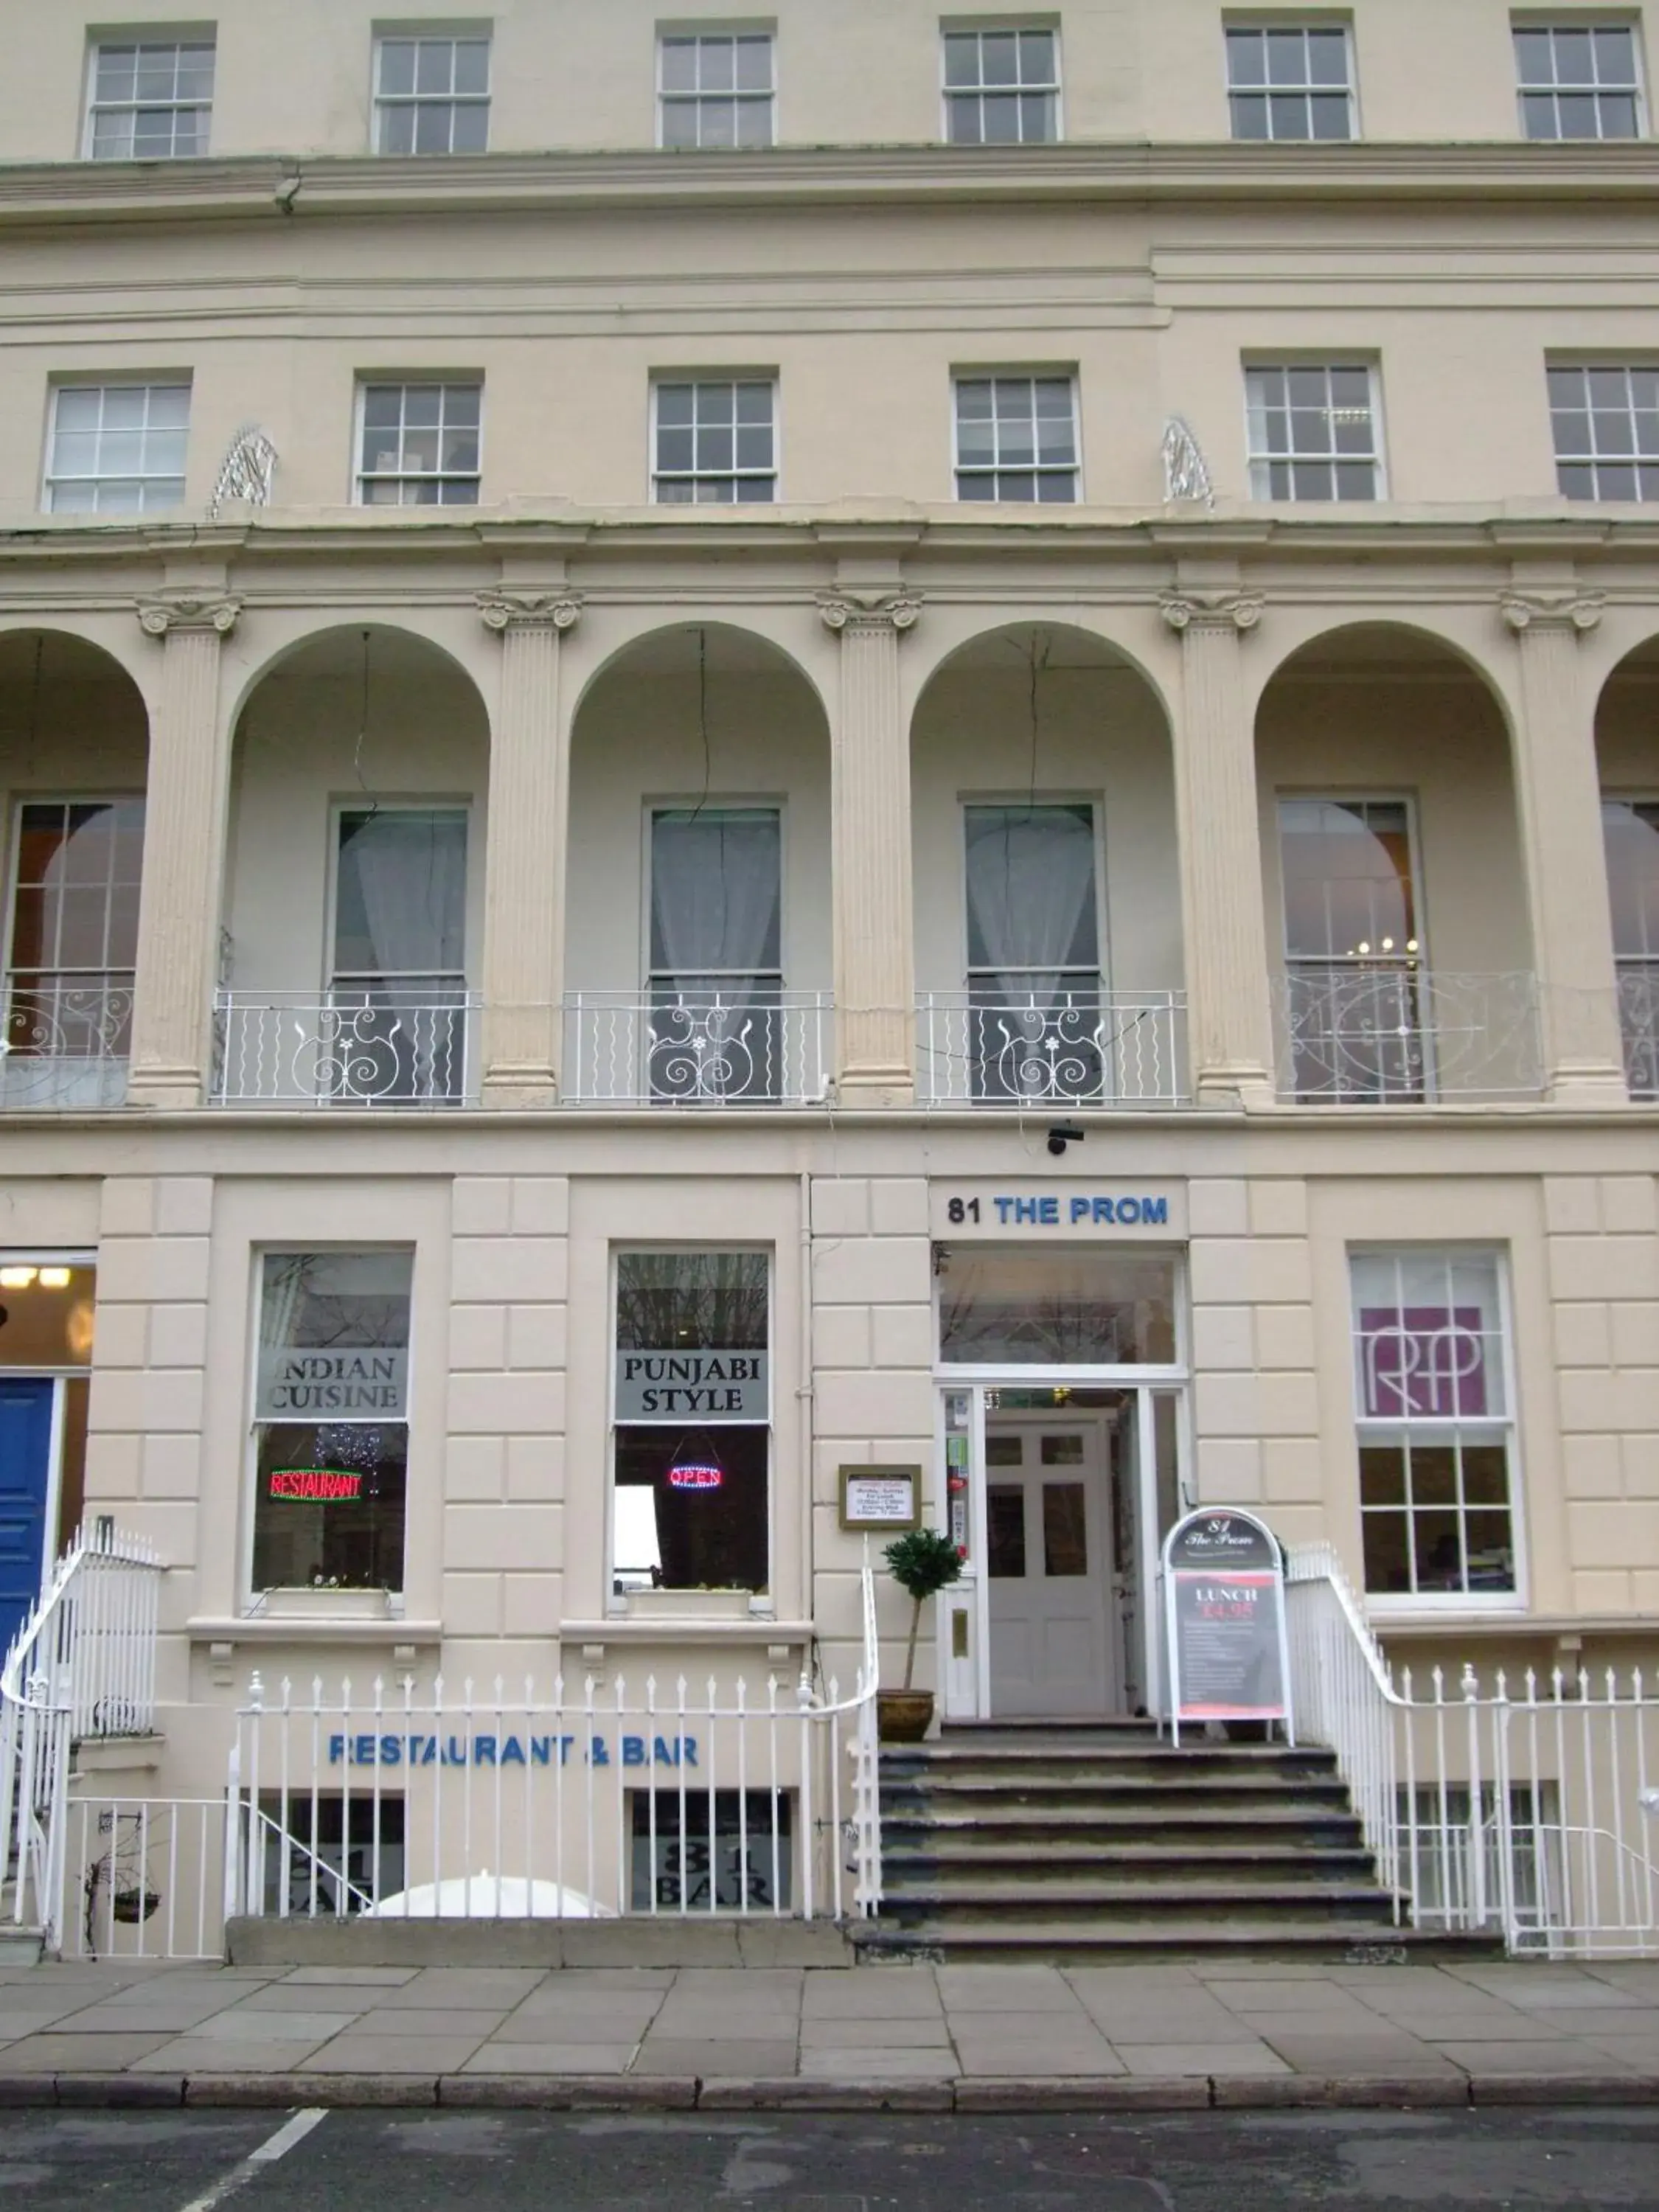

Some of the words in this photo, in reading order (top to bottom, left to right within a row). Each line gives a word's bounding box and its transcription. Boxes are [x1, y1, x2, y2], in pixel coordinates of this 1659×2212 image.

[947, 1197, 981, 1224] 81
[993, 1197, 1060, 1224] THE
[1070, 1197, 1168, 1224] PROM
[625, 1358, 760, 1385] PUNJABI
[273, 1385, 398, 1409] CUISINE
[641, 1388, 743, 1412] STYLE
[270, 1472, 361, 1499] RESTAURANT
[669, 1470, 721, 1485] OPEN
[1196, 1587, 1257, 1602] LUNCH
[329, 1735, 574, 1766] RESTAURANT
[585, 1736, 610, 1765] &
[622, 1736, 699, 1767] BAR
[665, 1842, 759, 1875] 81
[649, 1875, 774, 1906] BAR
